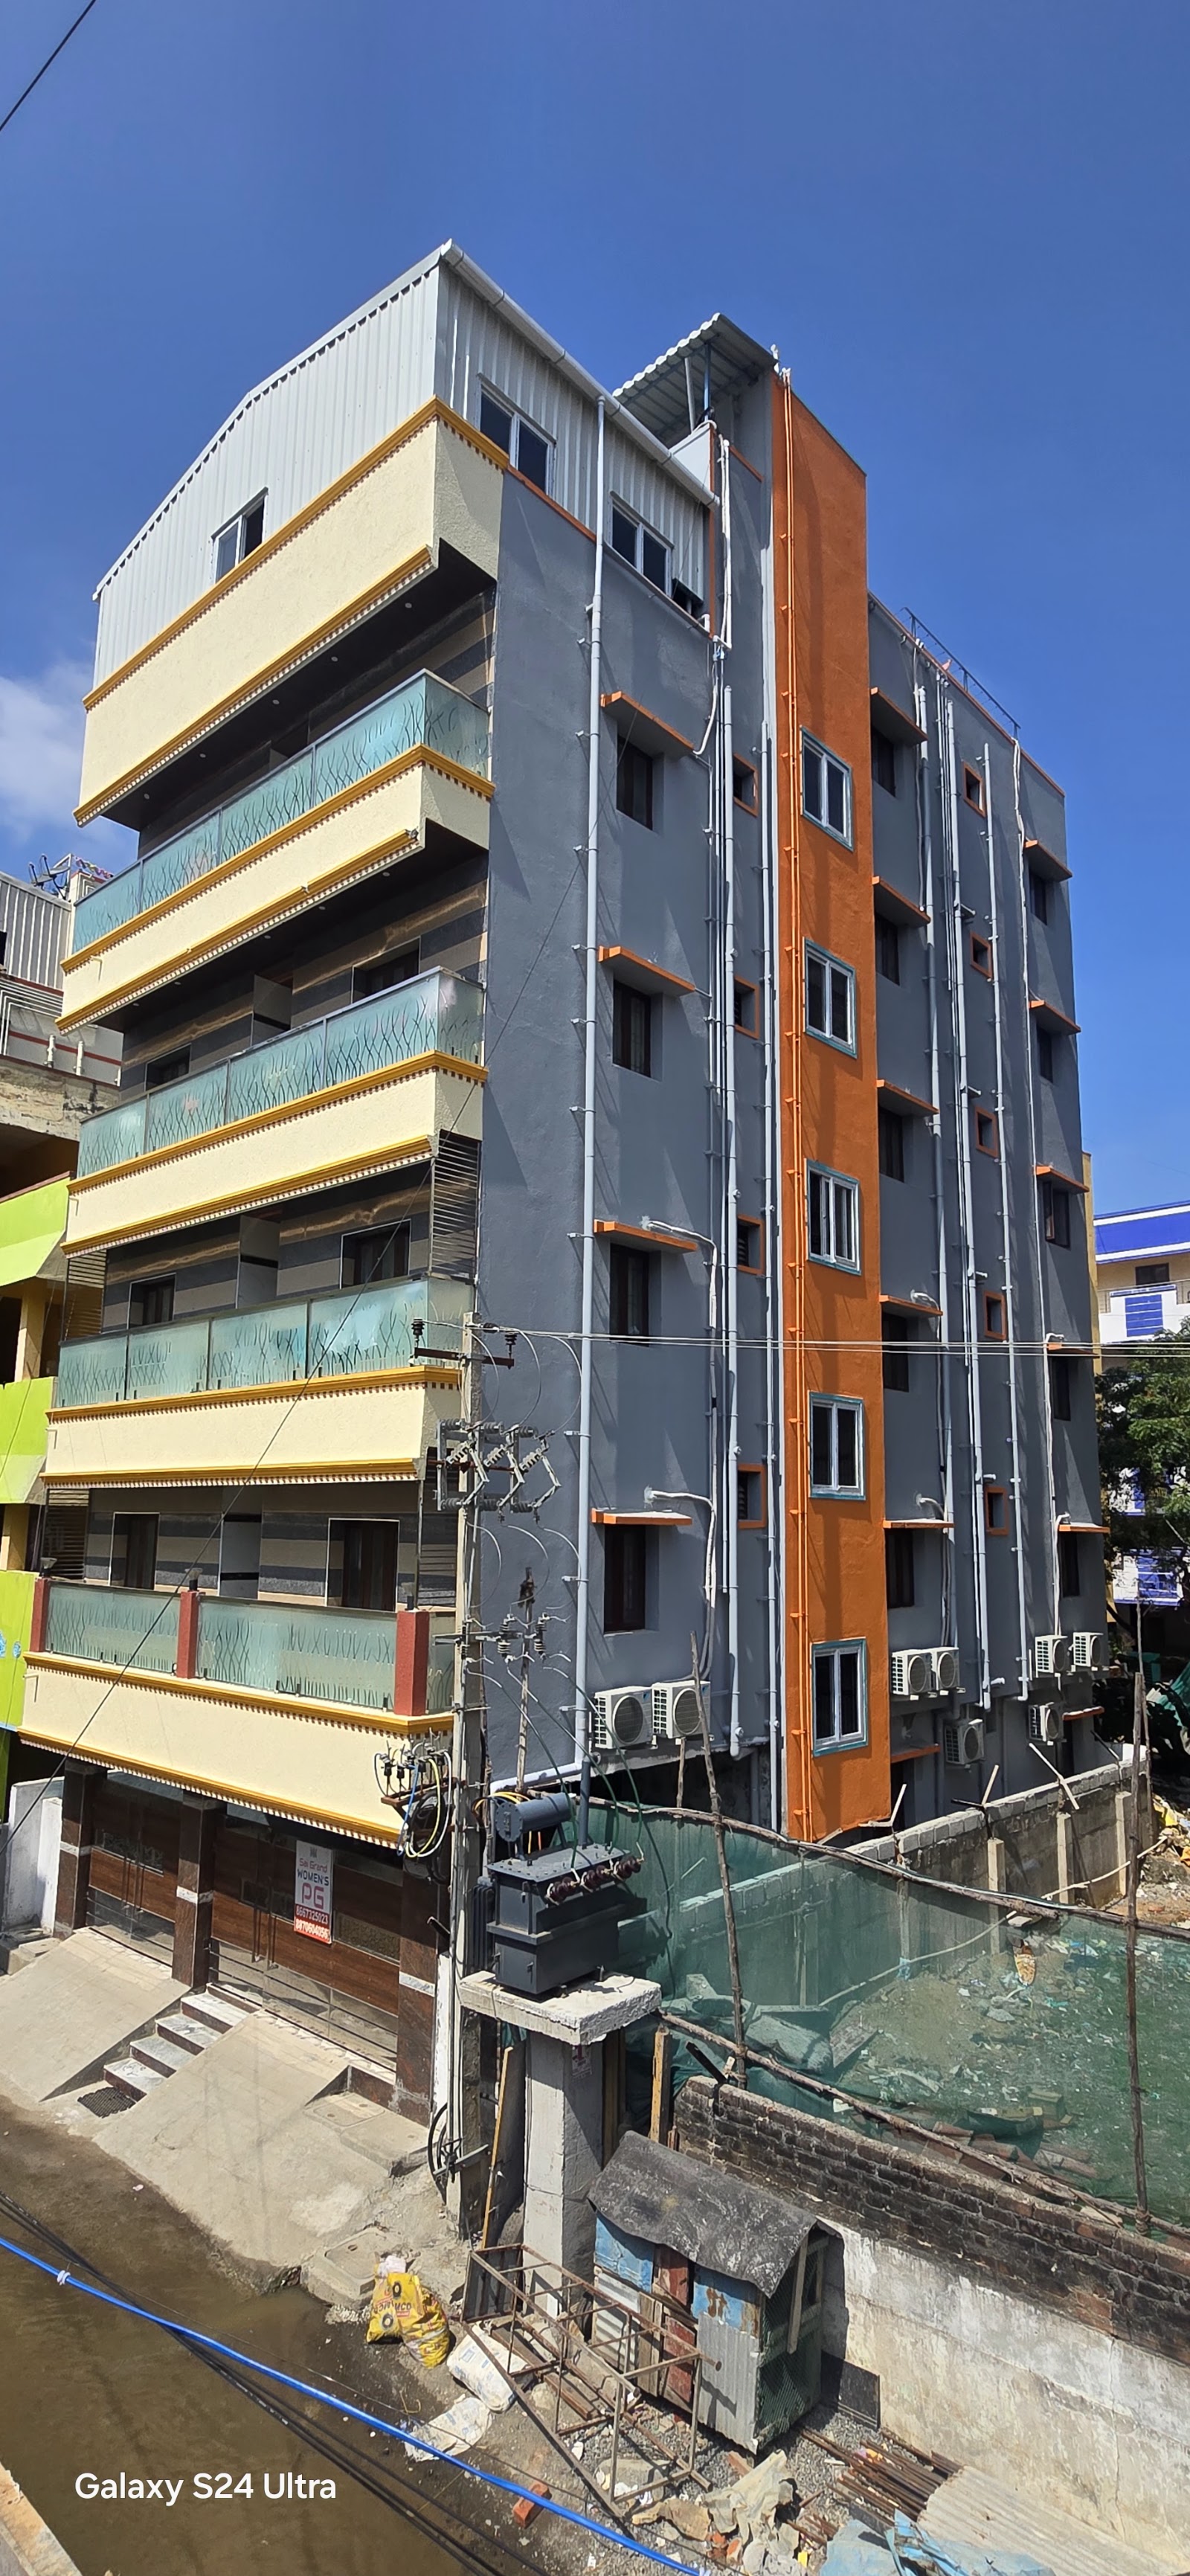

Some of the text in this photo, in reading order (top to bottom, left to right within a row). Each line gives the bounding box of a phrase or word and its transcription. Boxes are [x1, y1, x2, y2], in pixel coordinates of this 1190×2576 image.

[299, 1858, 327, 1873] Sai Grand
[297, 1869, 329, 1886] WOMEN'S
[302, 1883, 324, 1909] PG
